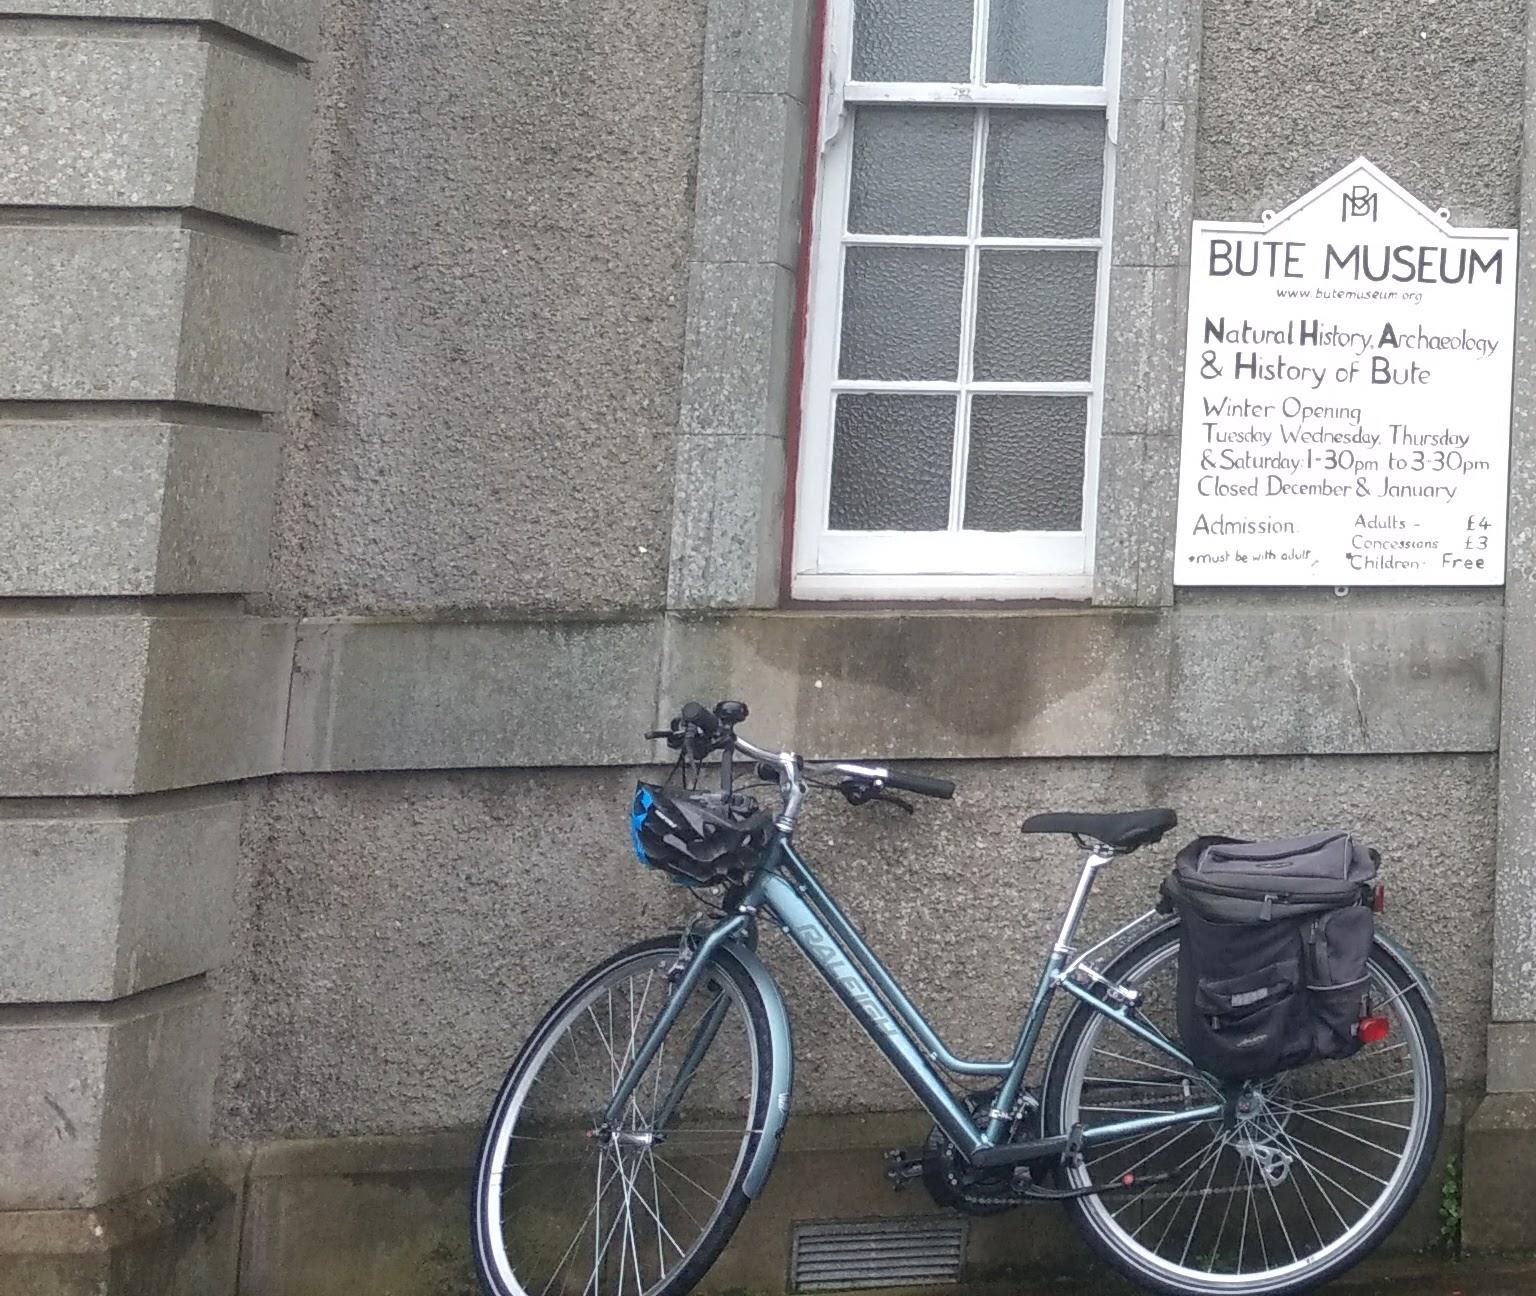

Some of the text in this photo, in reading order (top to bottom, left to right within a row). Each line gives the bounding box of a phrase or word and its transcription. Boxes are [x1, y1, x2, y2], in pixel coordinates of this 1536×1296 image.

[1209, 239, 1502, 284] BUTE MUSEUM
[1277, 288, 1422, 304] www.butemuseum.org
[1204, 317, 1294, 345] Natural
[1378, 322, 1499, 361] Archaeology
[1200, 350, 1430, 389] & History of Bute
[1203, 396, 1361, 426] Winter Opening
[1202, 423, 1272, 446] Tuesday
[1389, 425, 1469, 448] Thursday
[1308, 447, 1378, 475] 1-30pm
[1389, 452, 1407, 470] to
[1198, 473, 1456, 503] Closed December & January
[1193, 514, 1294, 535] Admission
[1355, 514, 1405, 529] Adults
[1467, 515, 1491, 530] £4
[1235, 550, 1247, 563] be
[1253, 550, 1276, 560] with
[1281, 548, 1311, 560] adult
[1352, 535, 1488, 550] Concessions £3
[1443, 553, 1484, 569] Free
[798, 923, 898, 1037] RALEIGH
